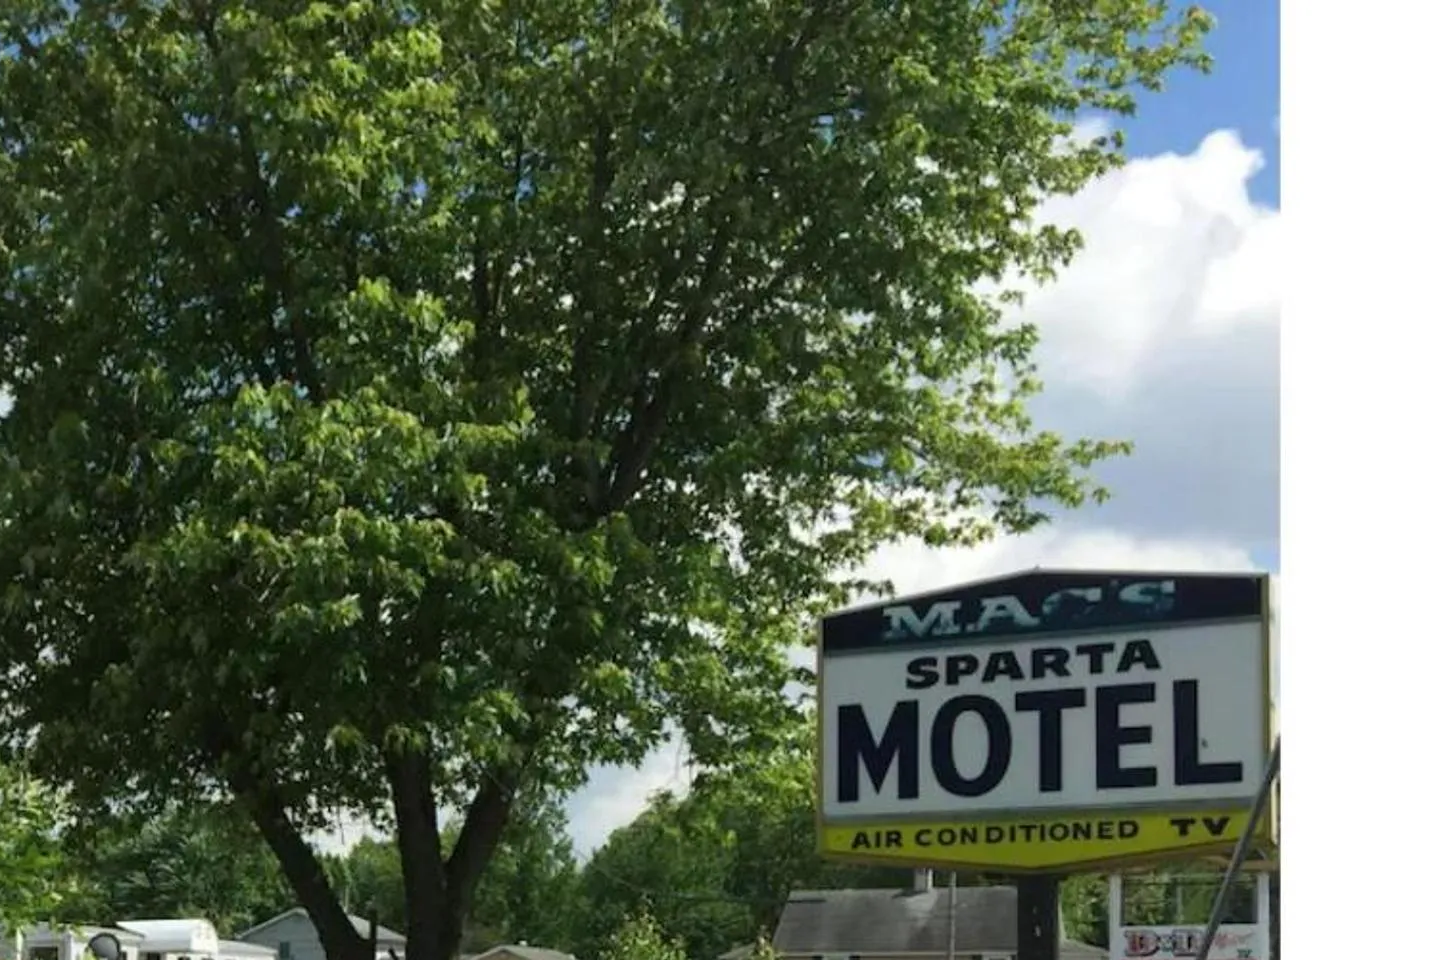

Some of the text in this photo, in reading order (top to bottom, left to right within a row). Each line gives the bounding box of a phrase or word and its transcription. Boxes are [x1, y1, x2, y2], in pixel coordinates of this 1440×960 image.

[905, 638, 1163, 690] SPARTA
[837, 678, 1244, 803] MOTEL
[850, 816, 1233, 850] AIR CONDITIONED TV
